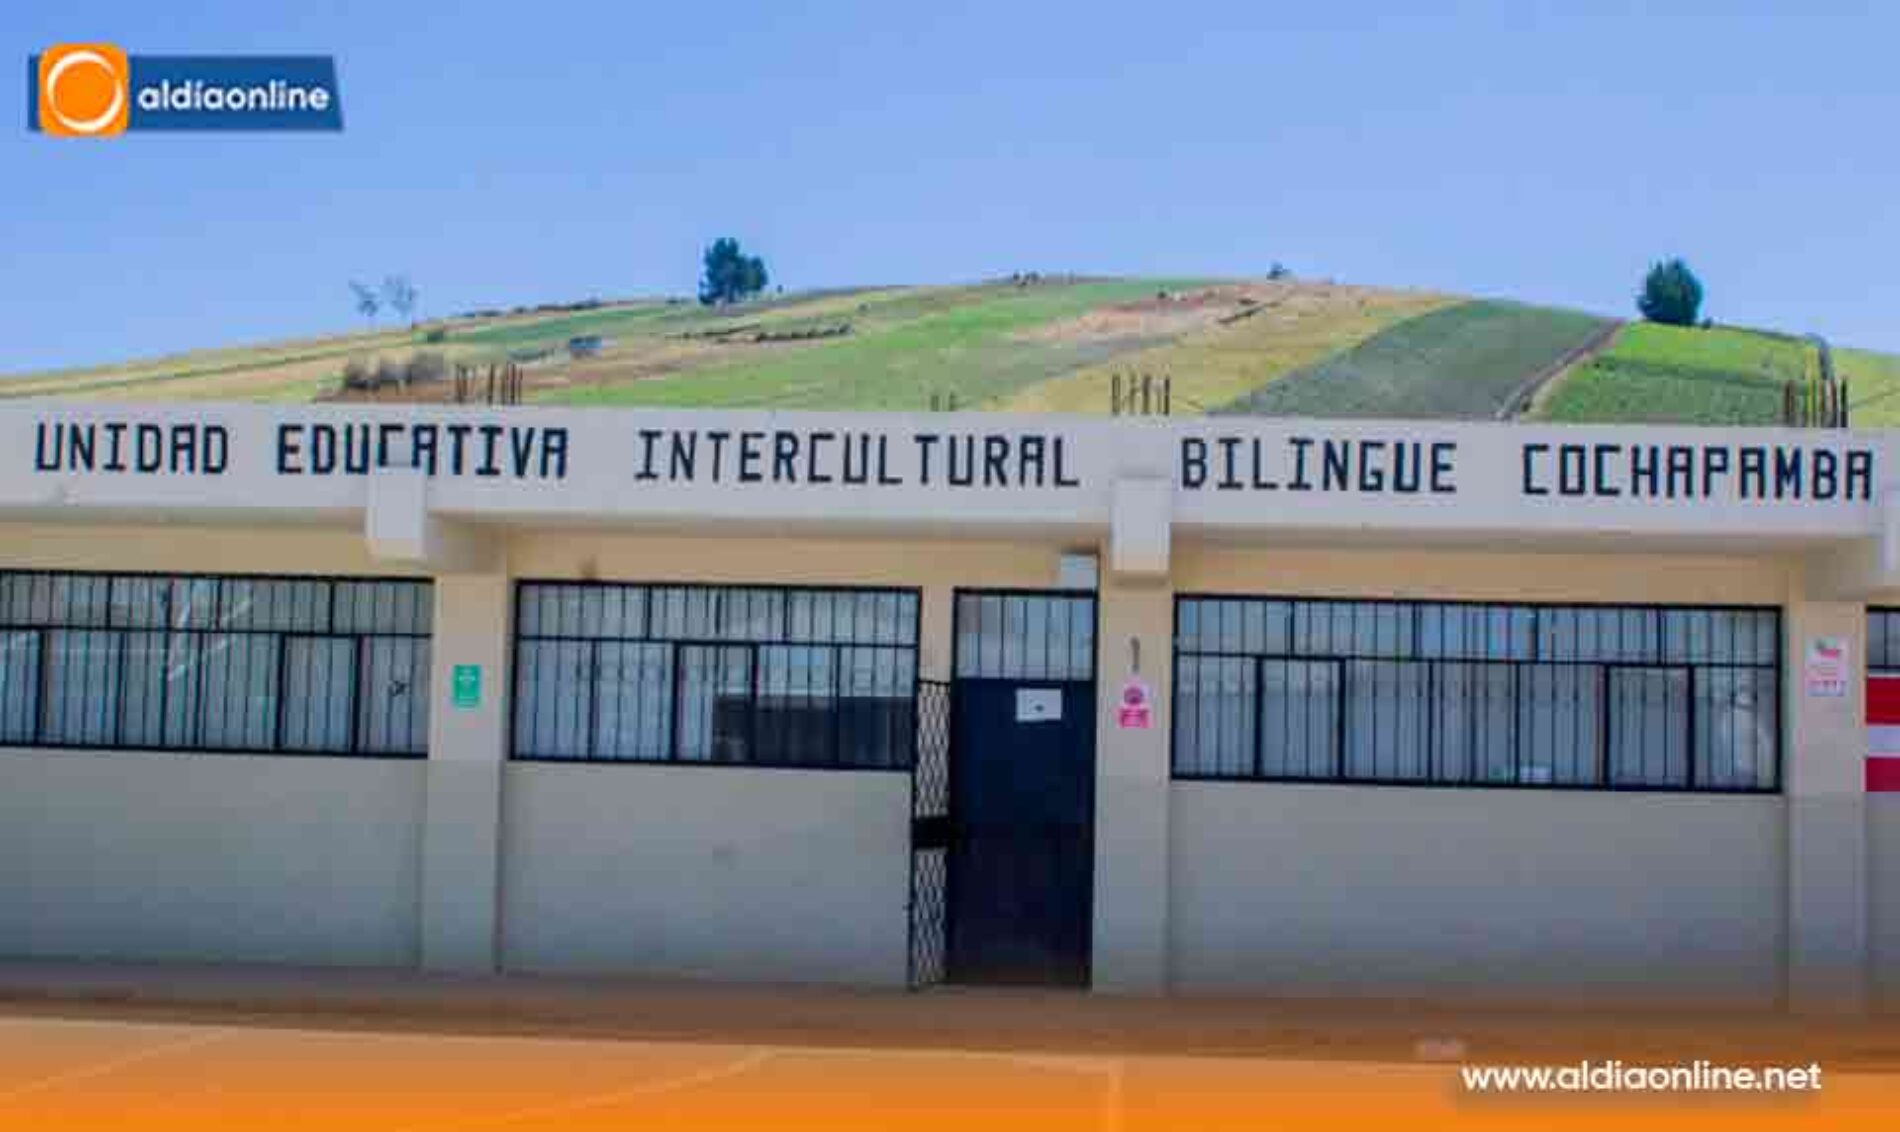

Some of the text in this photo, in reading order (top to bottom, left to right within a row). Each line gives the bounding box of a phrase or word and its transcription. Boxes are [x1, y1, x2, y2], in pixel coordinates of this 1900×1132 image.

[34, 422, 229, 475] UNIDAD
[634, 429, 1080, 488] INTERCULTURAL
[1181, 436, 1457, 494] BILINGUE
[1522, 443, 1873, 502] COCHAPAMBA
